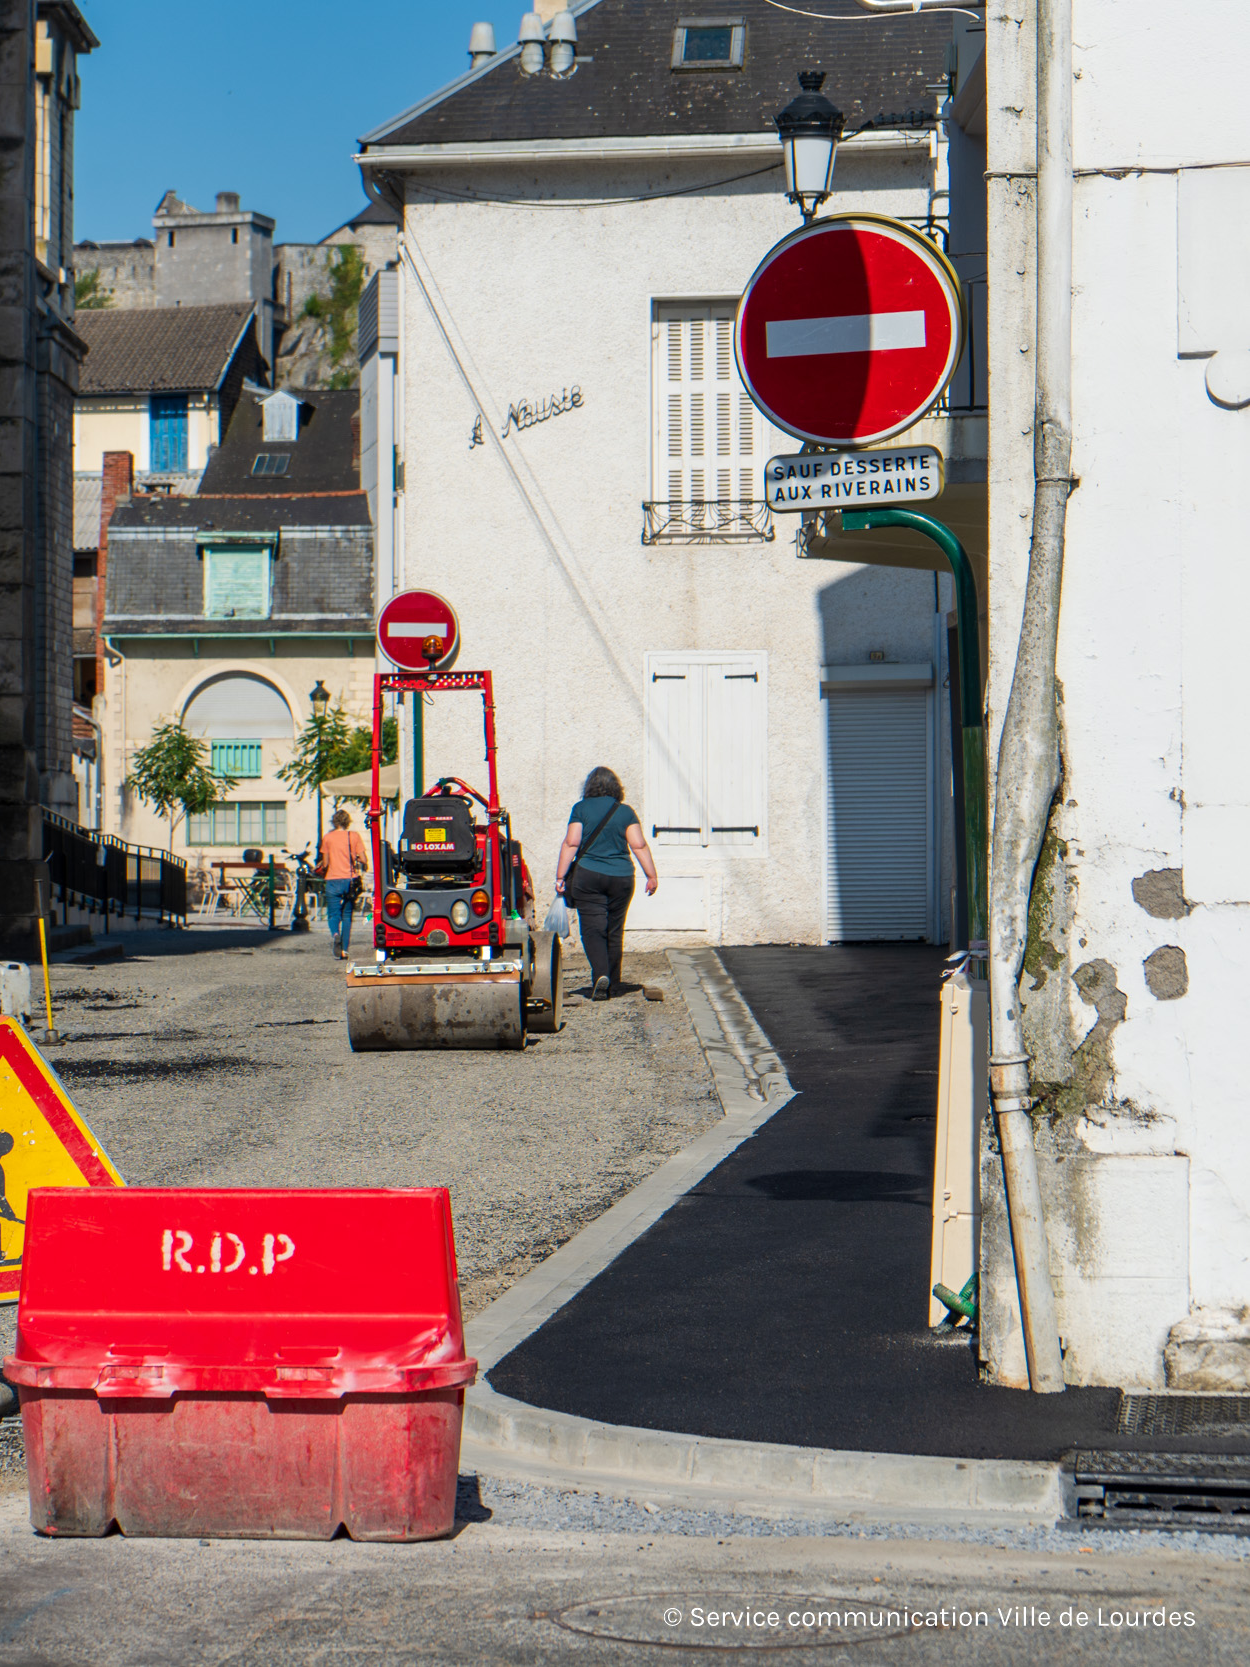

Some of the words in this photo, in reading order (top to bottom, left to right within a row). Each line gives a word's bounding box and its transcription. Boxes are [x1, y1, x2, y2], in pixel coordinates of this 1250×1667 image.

[773, 462, 823, 481] SAUF
[830, 454, 930, 477] DESSERTE
[775, 484, 812, 502] AUX
[821, 476, 931, 499] RIVERAINS
[423, 843, 455, 851] LOXAM
[161, 1229, 296, 1276] R.D.P
